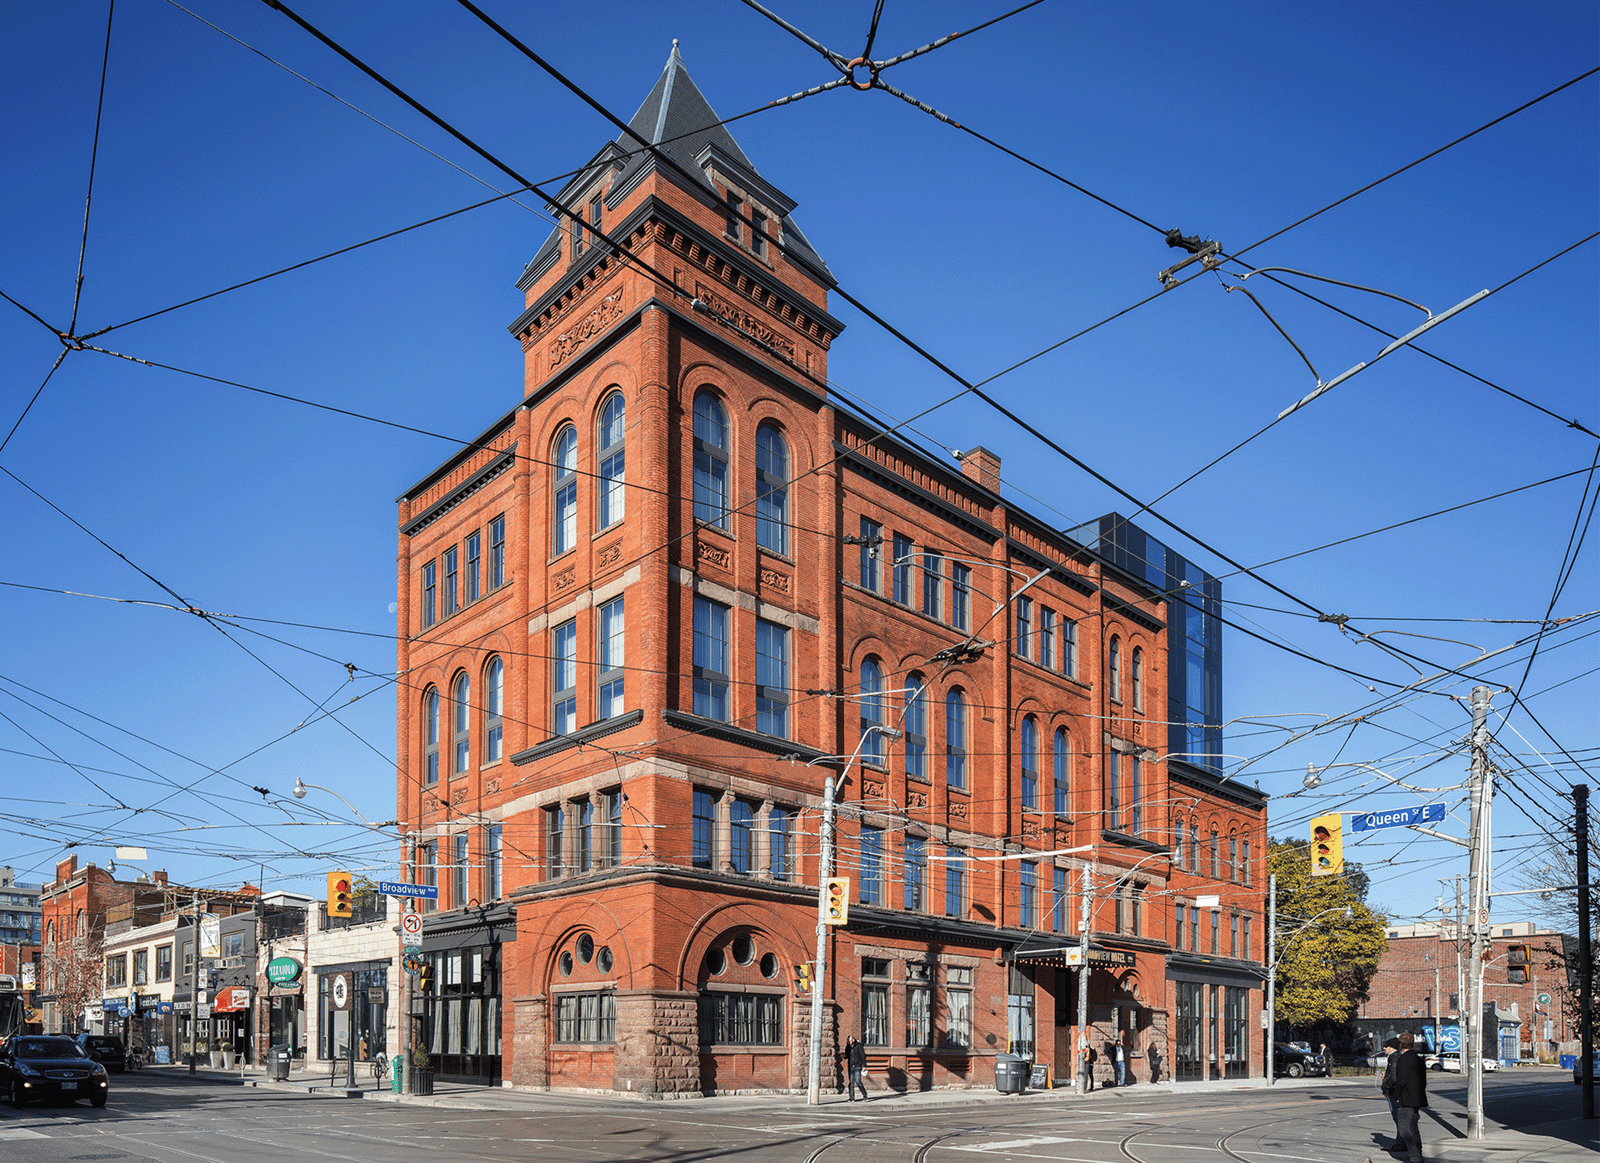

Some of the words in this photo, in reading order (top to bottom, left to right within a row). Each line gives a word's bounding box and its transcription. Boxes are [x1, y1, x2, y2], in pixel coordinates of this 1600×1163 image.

[1366, 812, 1408, 827] Queen
[1412, 808, 1419, 816] St
[1422, 807, 1430, 819] E
[382, 883, 426, 895] Broadview
[1111, 951, 1126, 963] HOTEL
[268, 964, 295, 976] PIZZAIOLO
